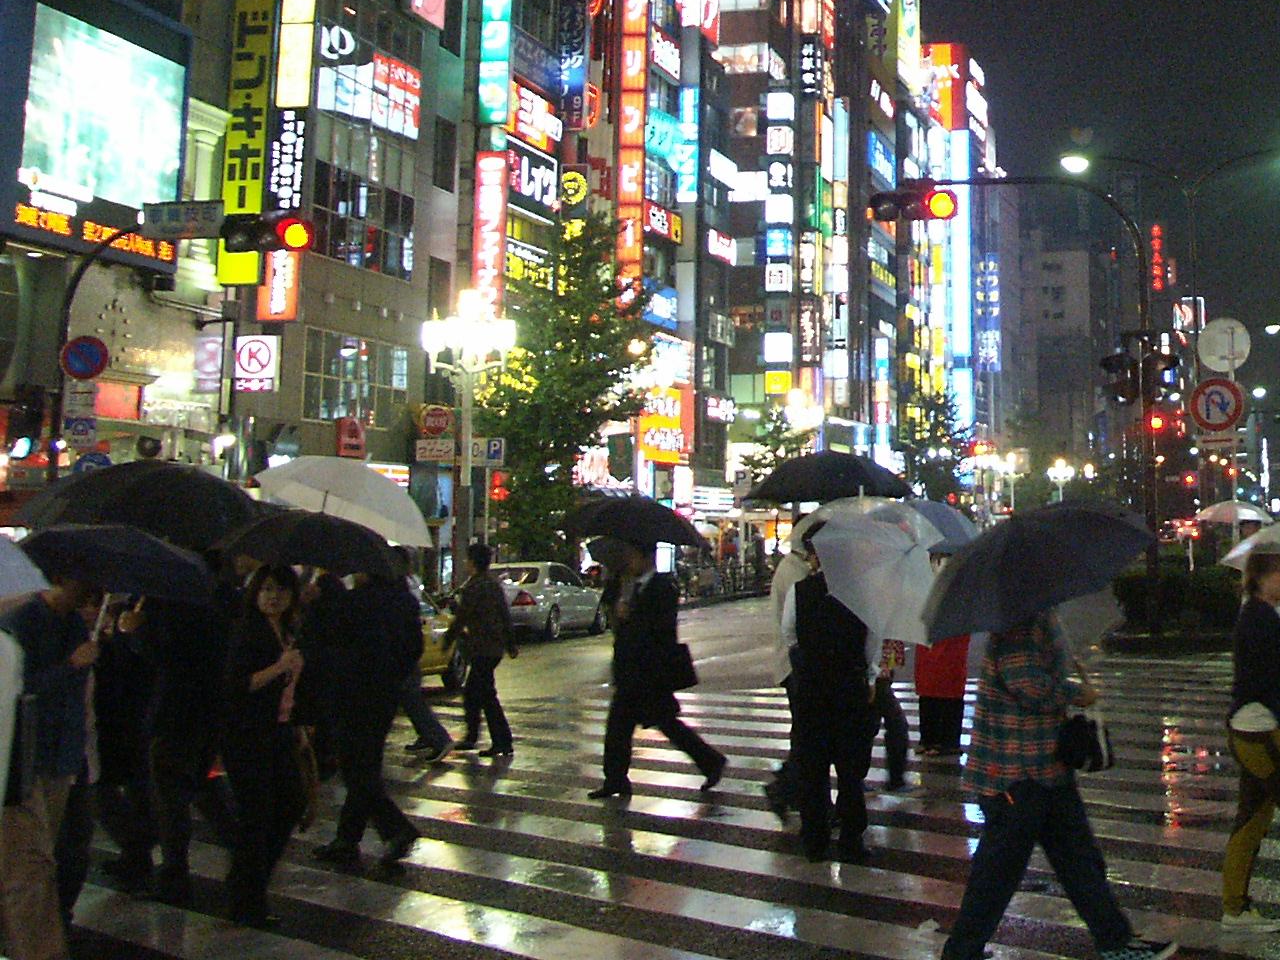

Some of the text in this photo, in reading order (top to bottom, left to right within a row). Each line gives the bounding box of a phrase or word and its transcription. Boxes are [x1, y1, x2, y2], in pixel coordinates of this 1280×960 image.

[226, 10, 269, 209] ドン・キホー
[489, 439, 500, 456] P
